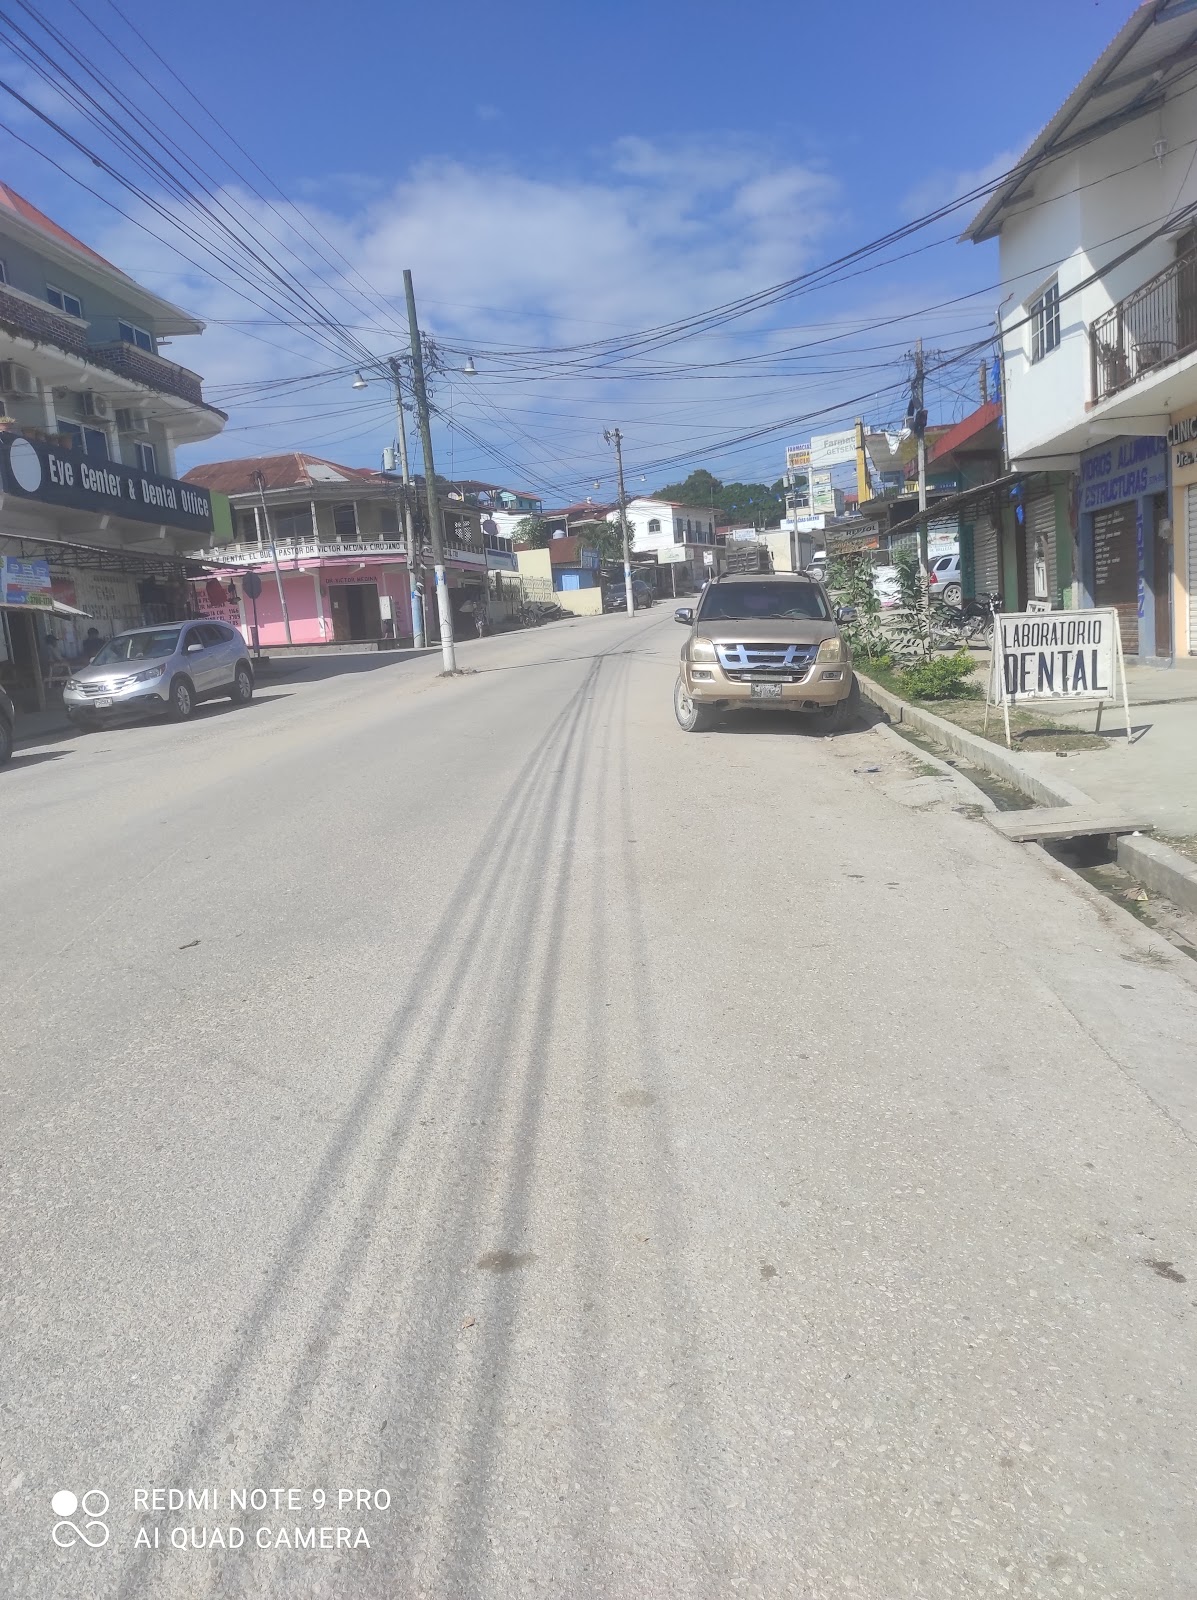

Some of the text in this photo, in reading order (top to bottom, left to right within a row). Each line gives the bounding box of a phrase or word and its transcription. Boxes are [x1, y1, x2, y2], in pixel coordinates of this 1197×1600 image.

[823, 436, 856, 448] Farmac
[1166, 416, 1197, 447] CLINIC
[826, 445, 856, 455] GETSEM
[48, 454, 209, 517] Eye Center & Dental Office
[1085, 467, 1148, 508] ESTRUCTURAS
[223, 555, 247, 563] DENTAL
[249, 552, 257, 560] EL
[279, 547, 303, 556] PASTOR
[318, 545, 341, 553] VICTOR
[343, 544, 368, 552] MEDINA
[369, 542, 400, 551] CIRUJANO
[1003, 620, 1102, 648] LABORATORIO
[1003, 649, 1108, 695] DENTAL
